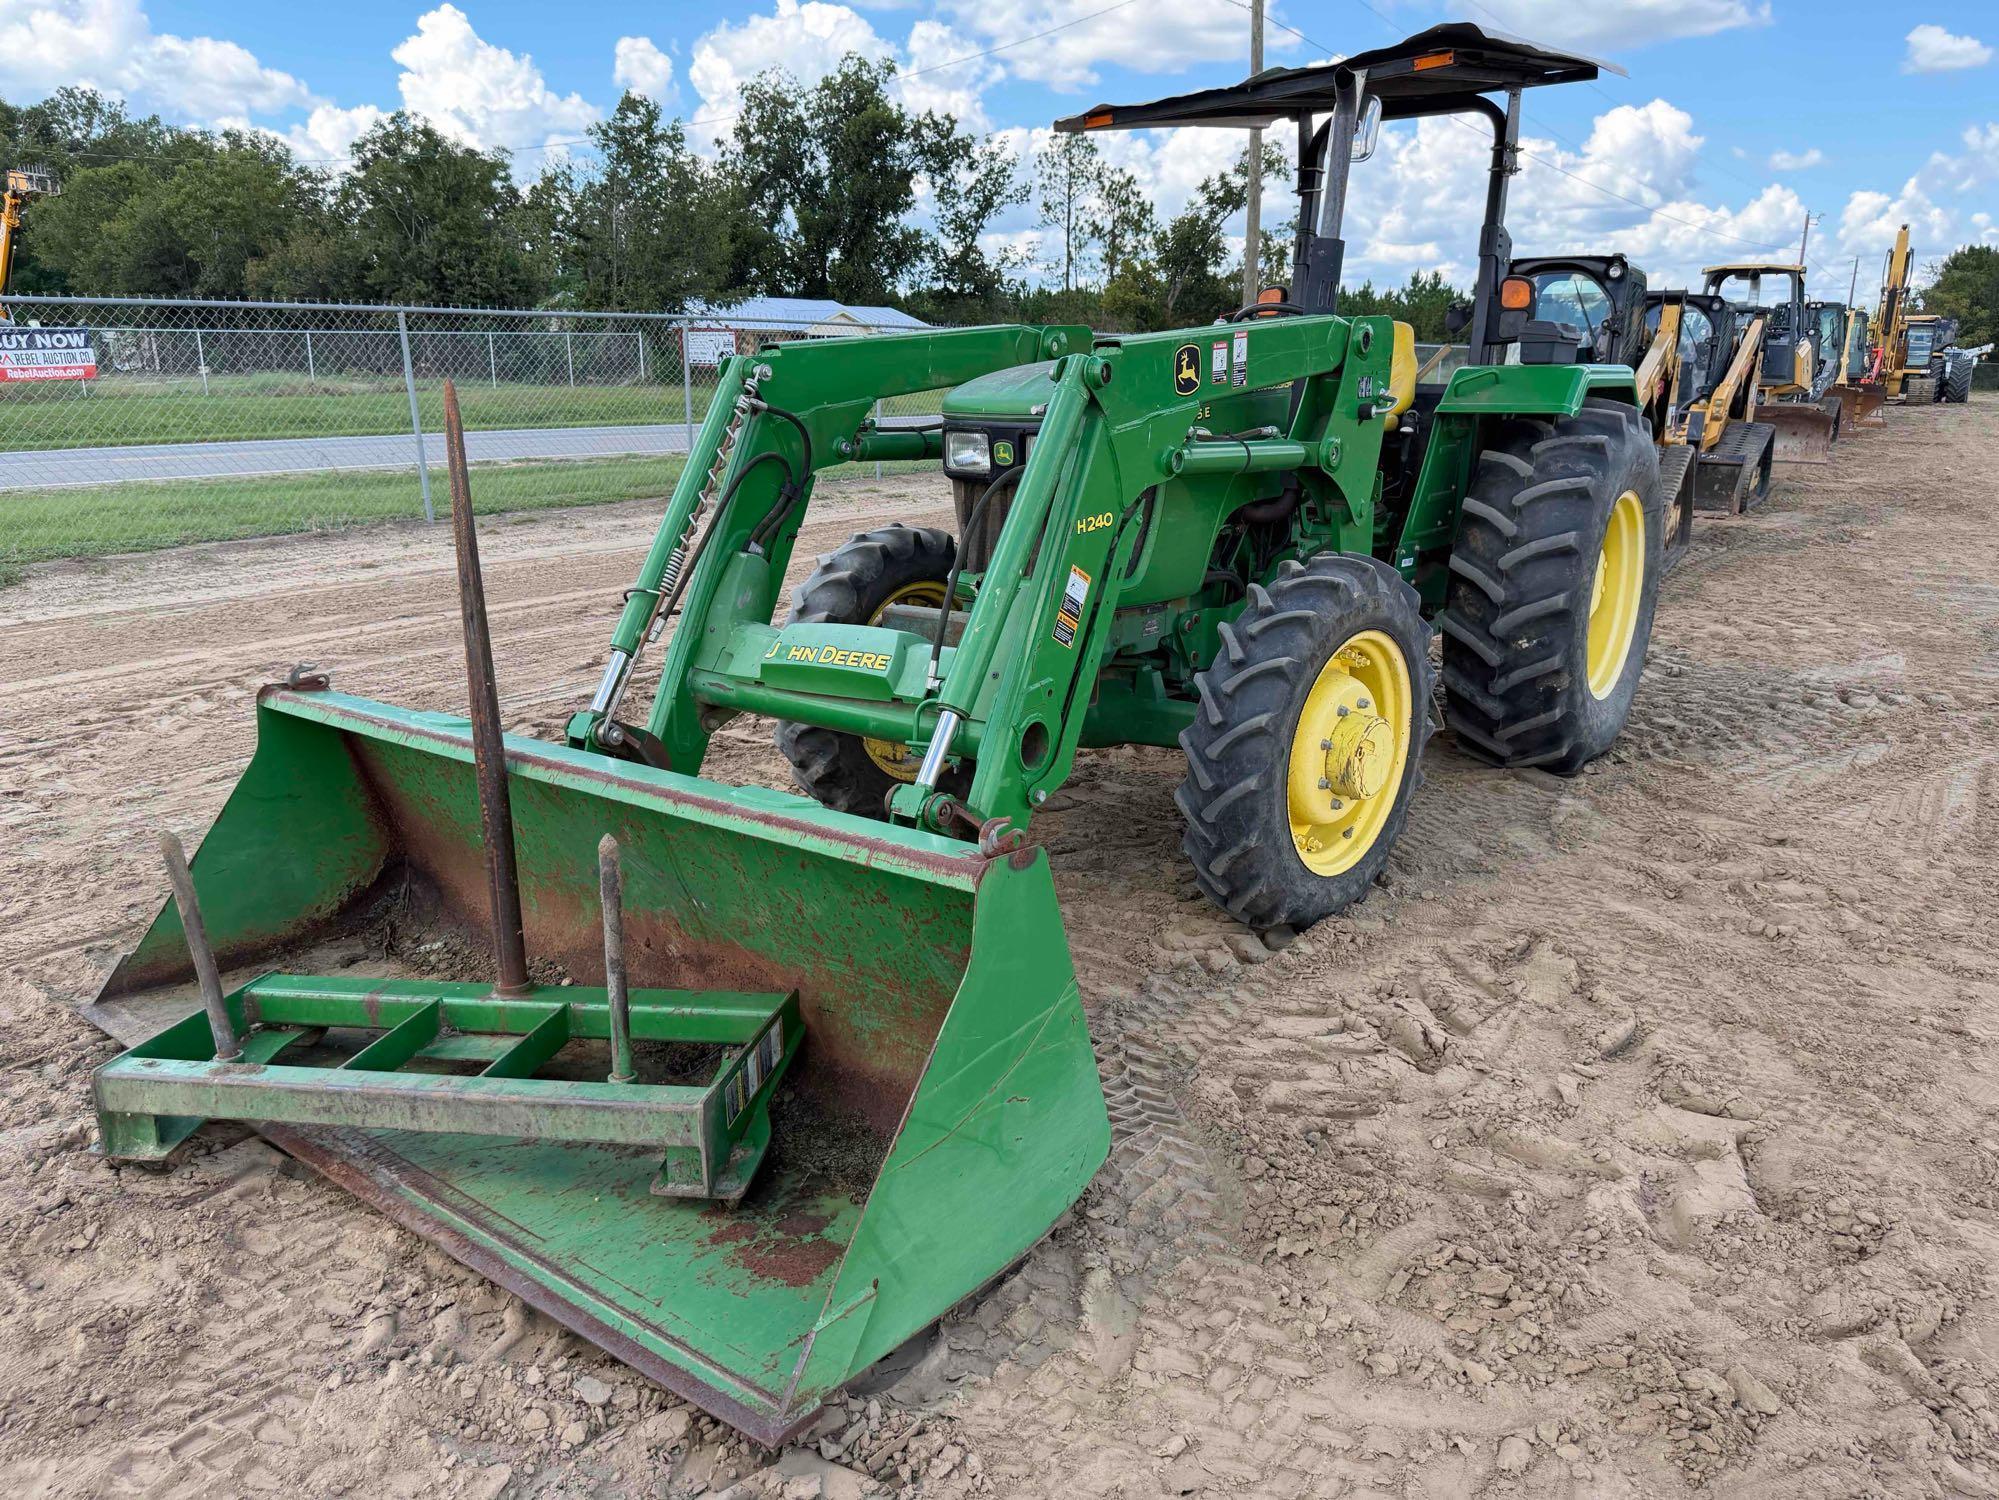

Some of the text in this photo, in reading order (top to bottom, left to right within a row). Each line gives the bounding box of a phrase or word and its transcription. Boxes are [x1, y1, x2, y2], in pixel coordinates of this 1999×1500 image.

[0, 333, 85, 349] UY NOW
[14, 352, 40, 366] REBEL
[43, 352, 78, 365] AUCTION
[80, 351, 93, 364] CO.
[7, 368, 84, 379] RebelAuction.com
[1077, 512, 1113, 535] H240
[764, 641, 893, 671] JHN DEERE
